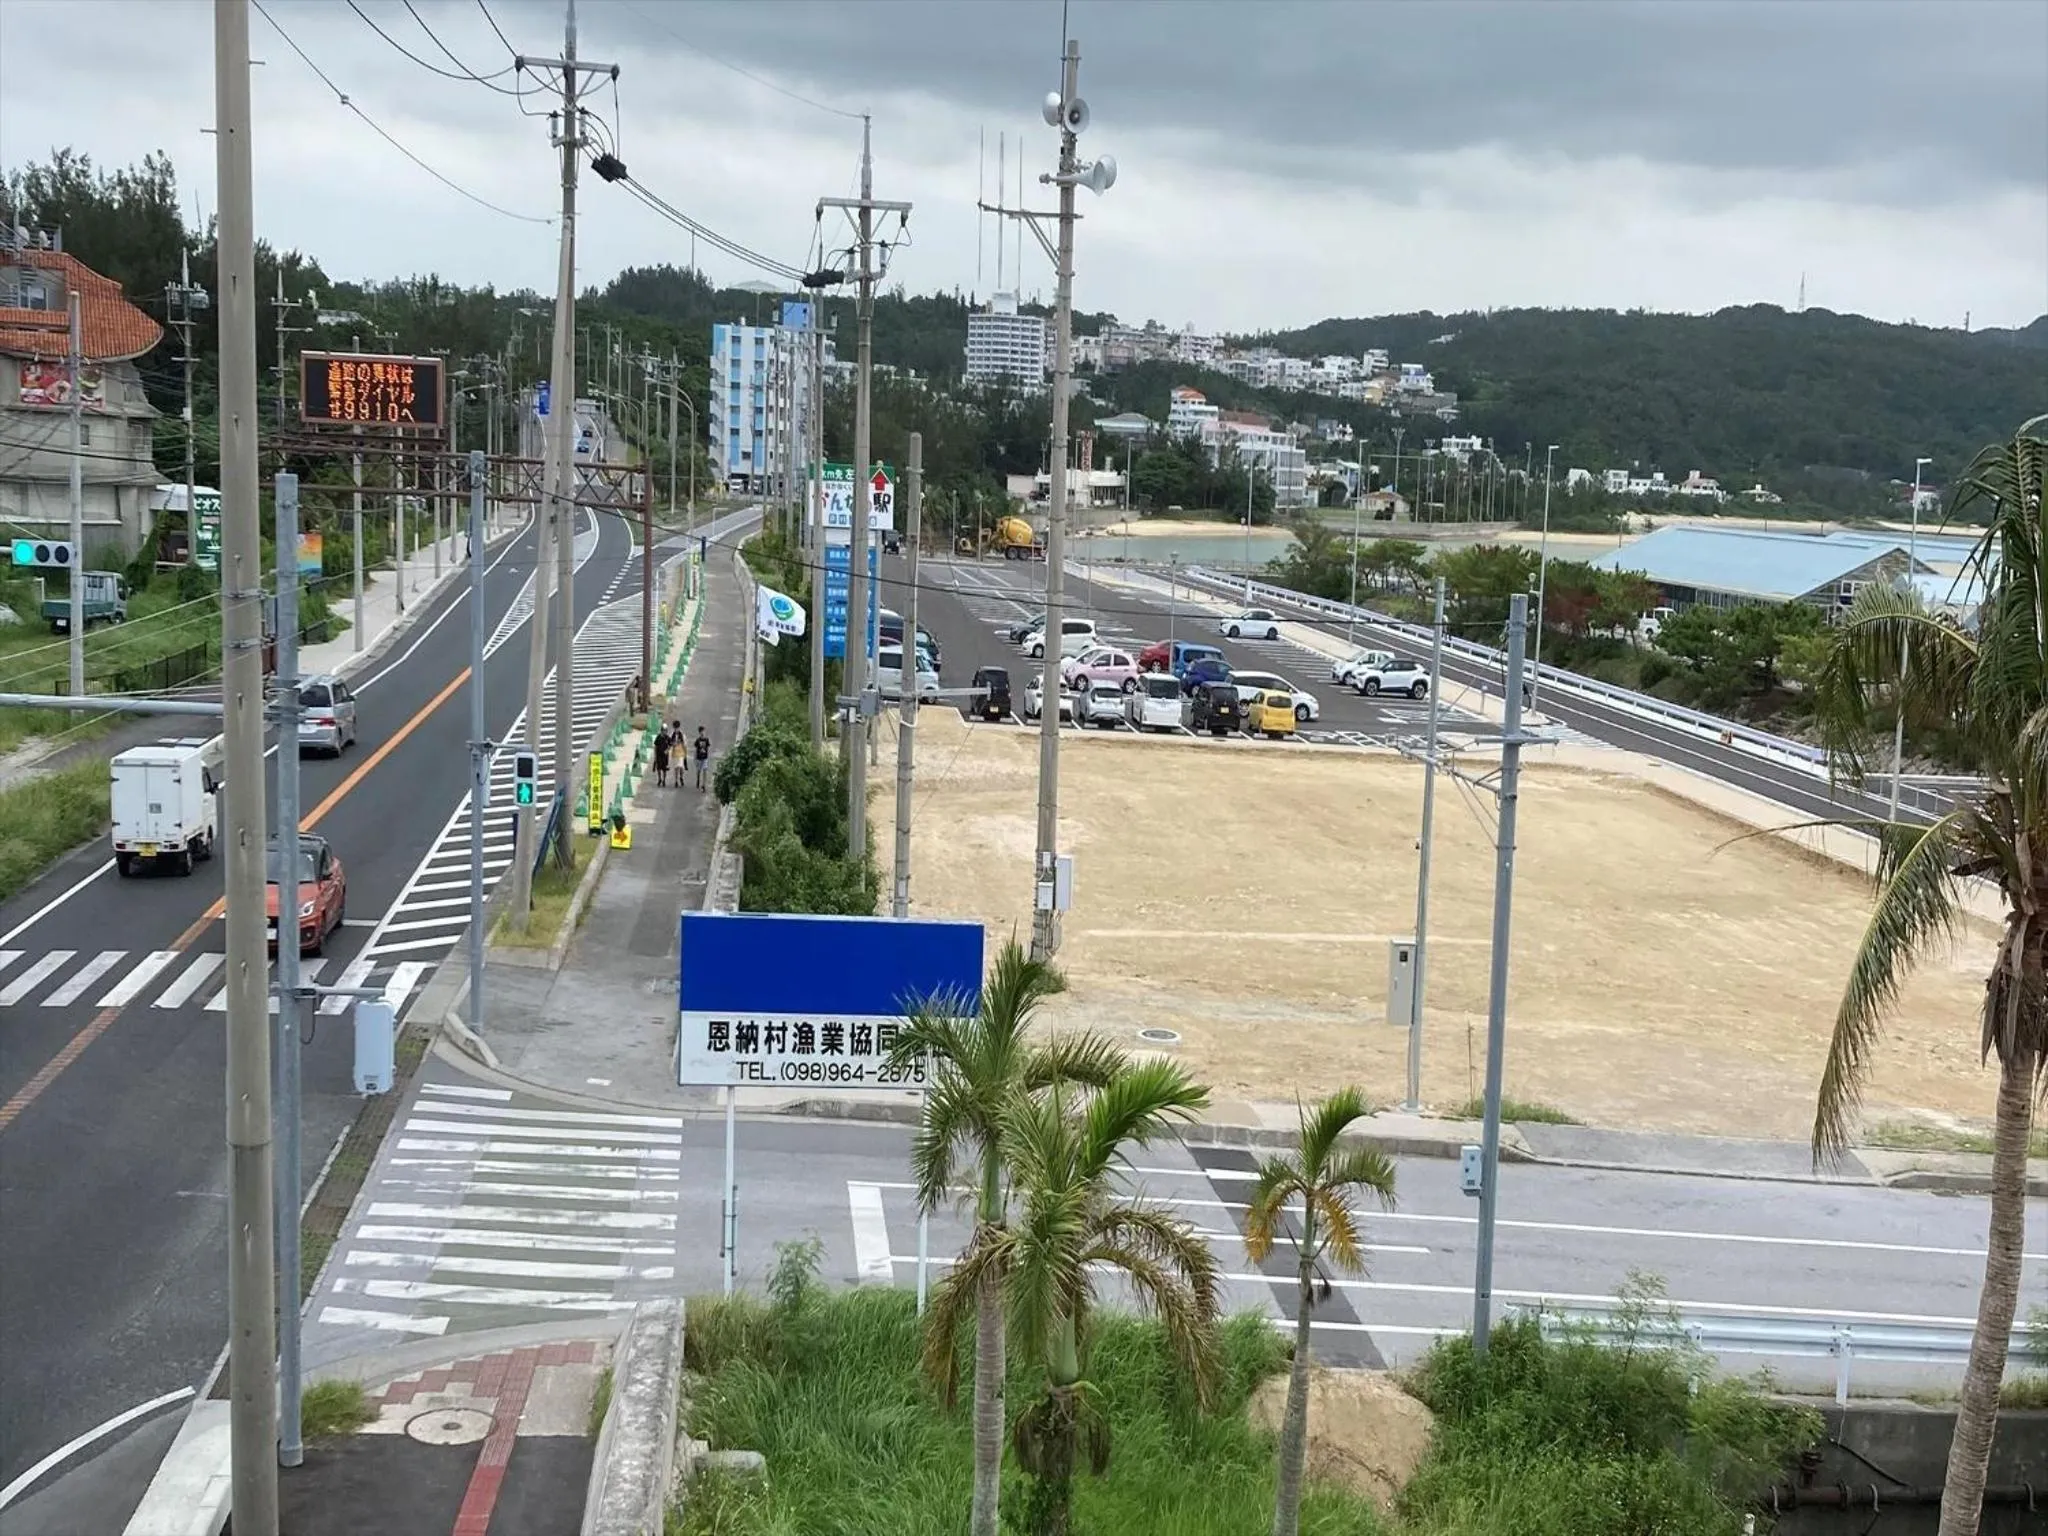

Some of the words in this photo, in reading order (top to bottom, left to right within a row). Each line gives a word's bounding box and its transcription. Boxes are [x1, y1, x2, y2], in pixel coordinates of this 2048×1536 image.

[707, 1020, 948, 1058] 恩納村漁業協同
